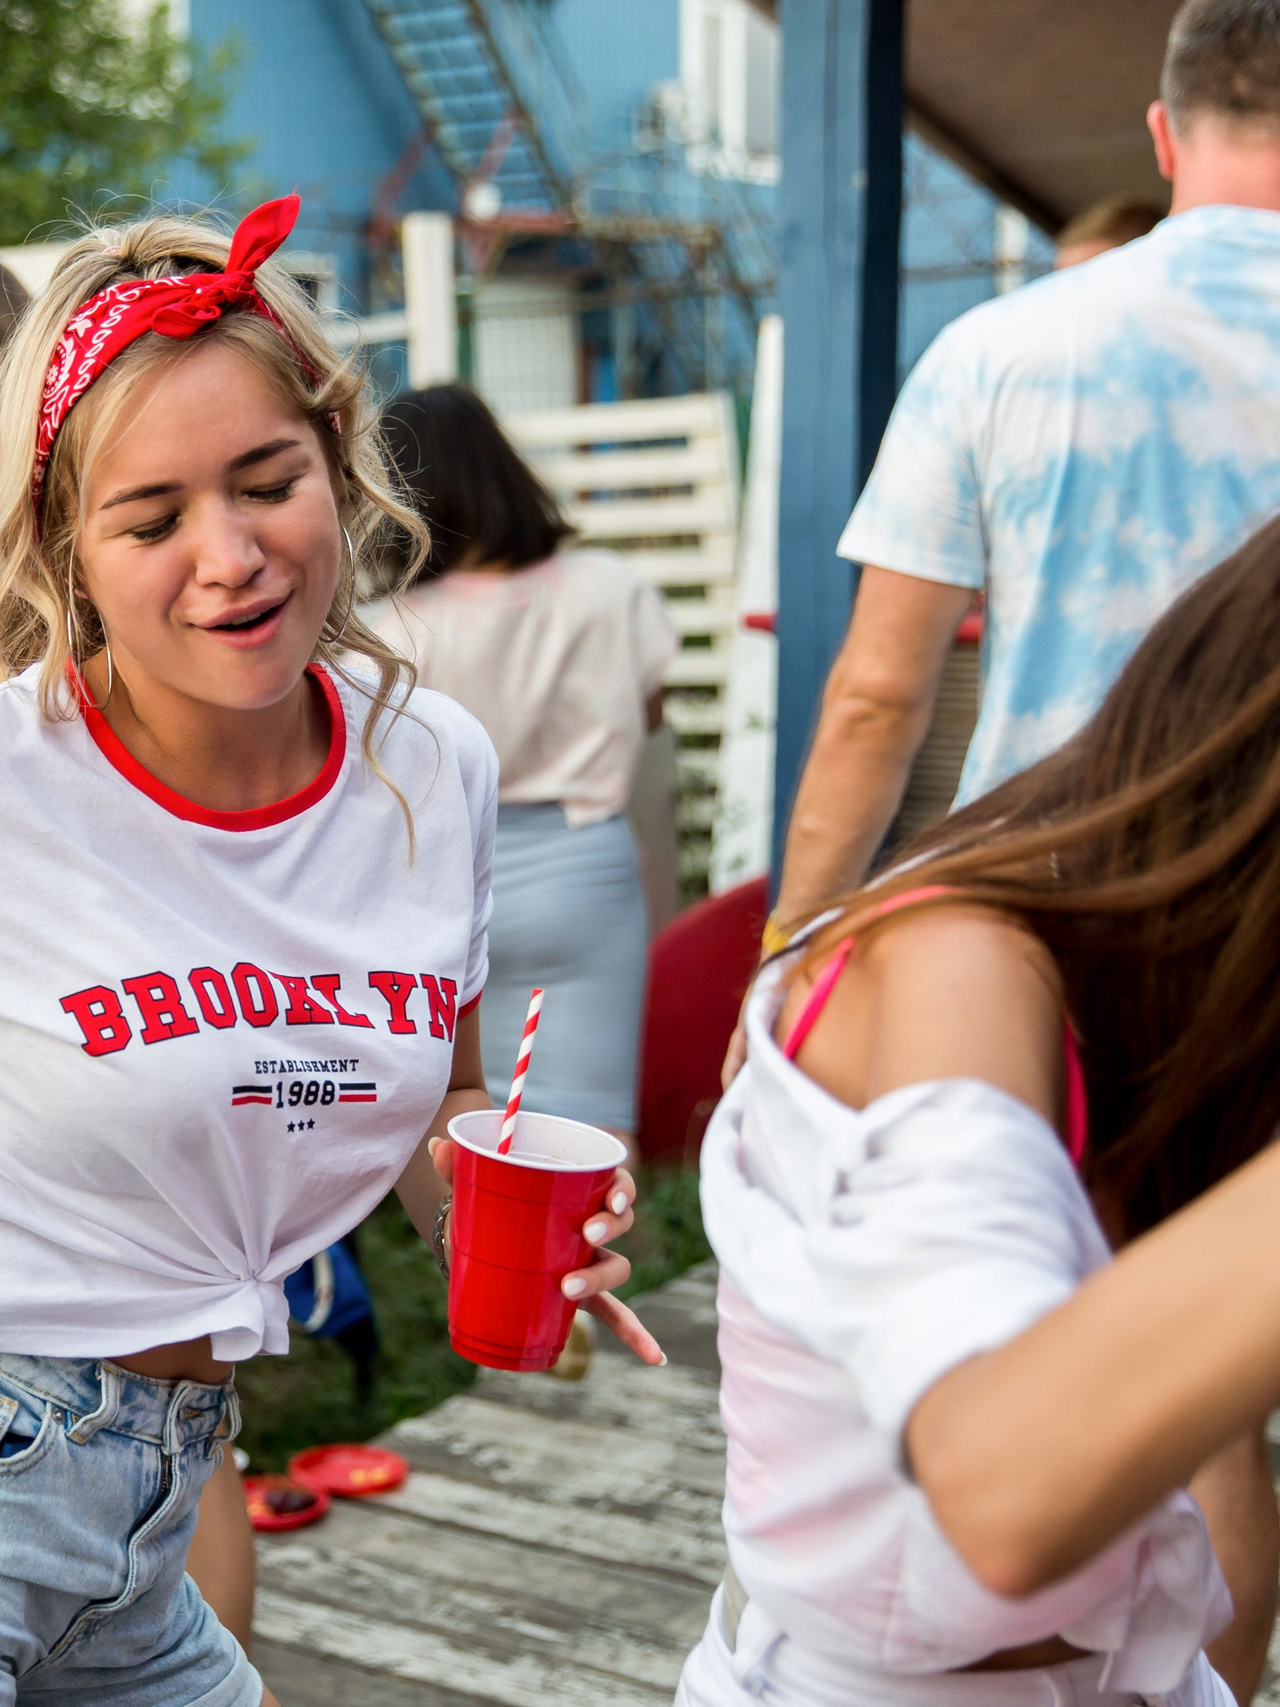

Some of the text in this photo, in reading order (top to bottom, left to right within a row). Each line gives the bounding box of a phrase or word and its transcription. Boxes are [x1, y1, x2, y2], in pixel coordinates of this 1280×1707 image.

[59, 962, 458, 1057] BROOKLYN
[254, 1059, 359, 1074] ESTABLISHMENT
[276, 1080, 336, 1109] 1988
